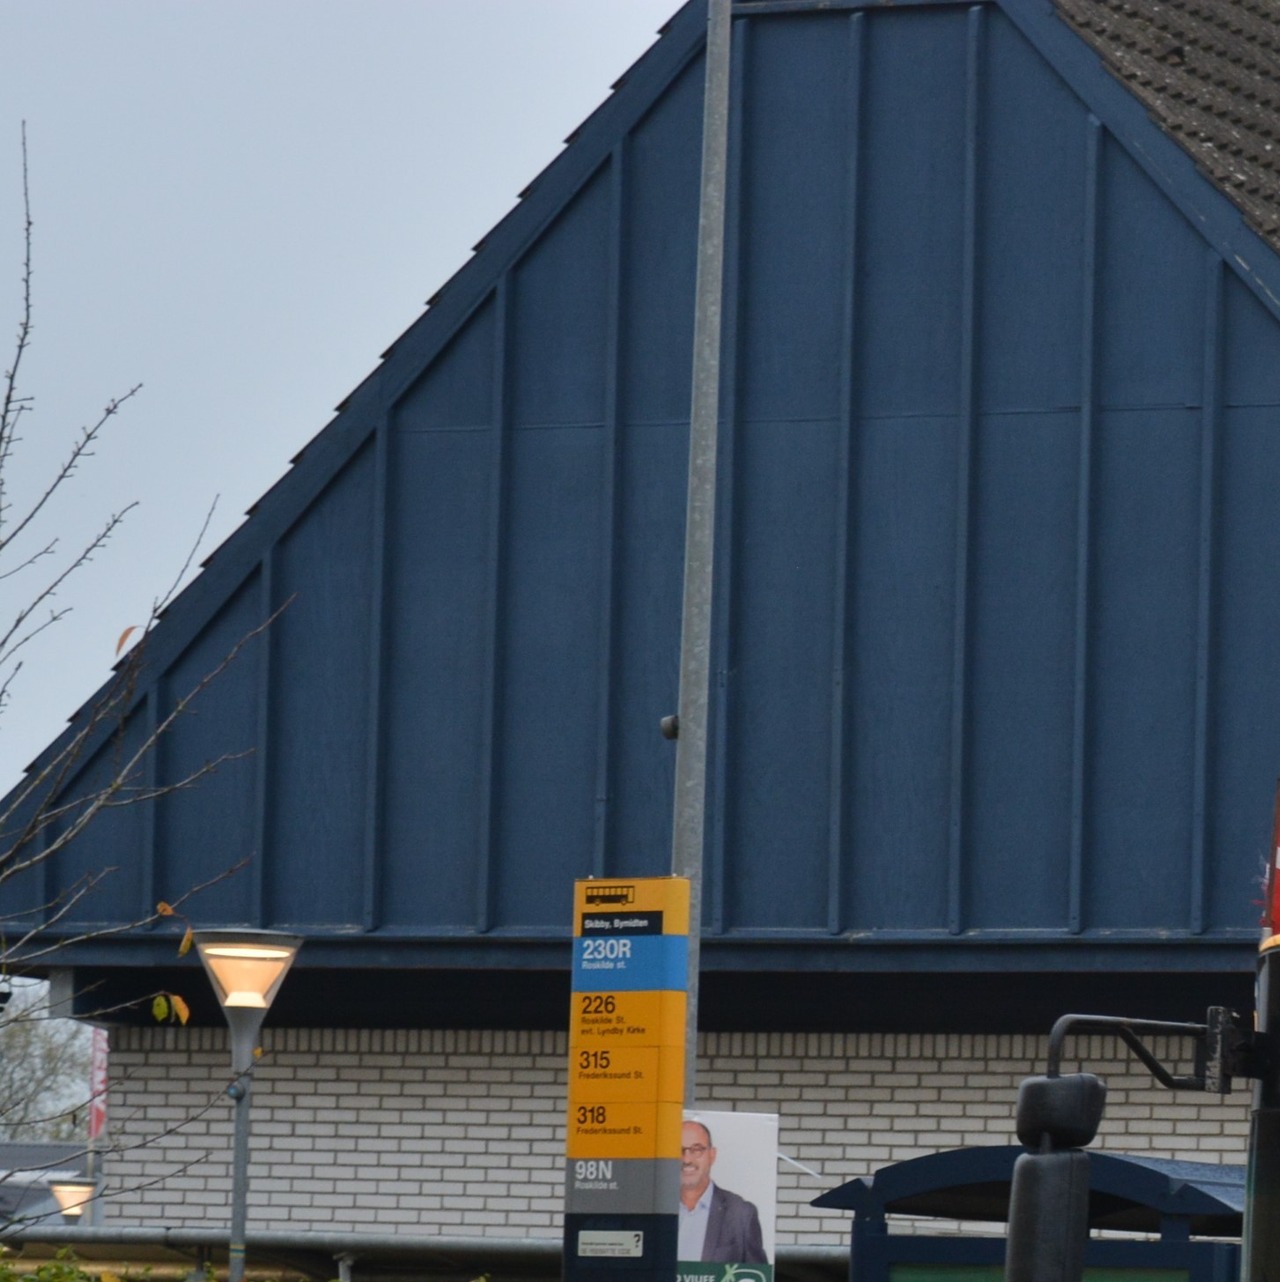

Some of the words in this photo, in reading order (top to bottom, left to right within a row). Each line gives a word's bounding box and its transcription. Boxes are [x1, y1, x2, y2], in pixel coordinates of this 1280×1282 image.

[582, 939, 632, 960] 230R
[582, 995, 616, 1015] 226
[579, 1050, 611, 1070] 315
[577, 1105, 606, 1125] 318
[575, 1160, 613, 1180] 98N
